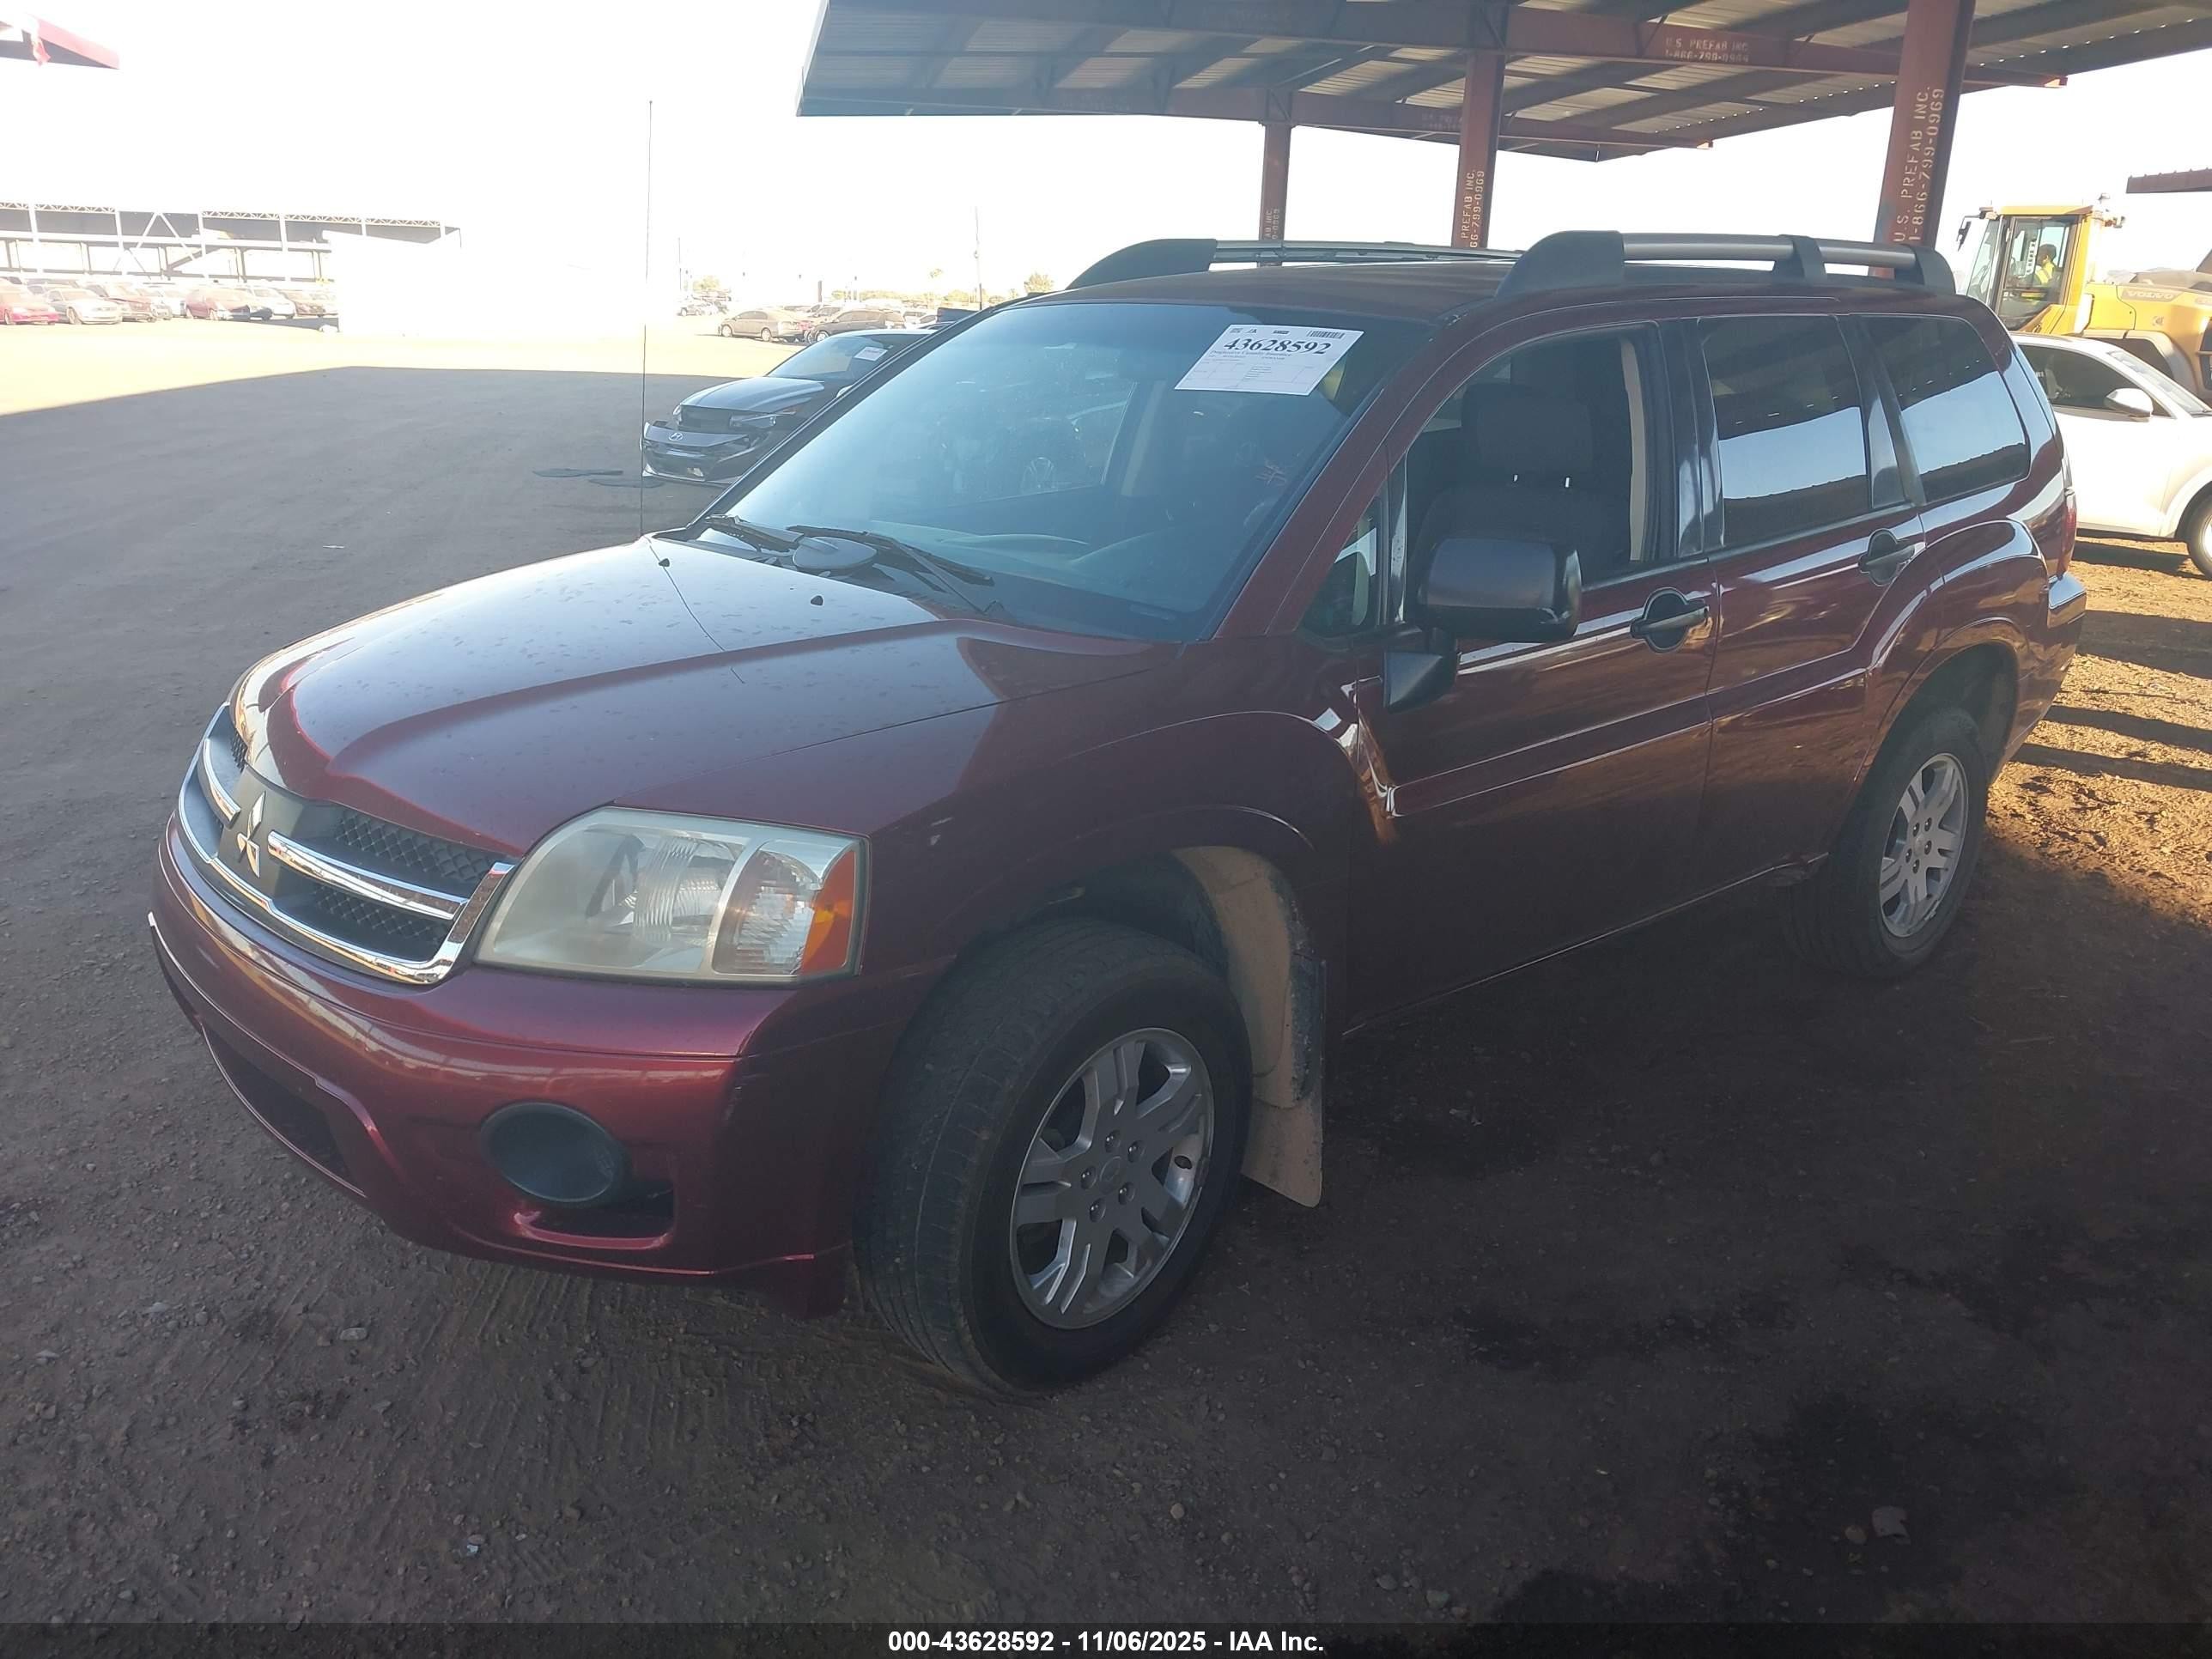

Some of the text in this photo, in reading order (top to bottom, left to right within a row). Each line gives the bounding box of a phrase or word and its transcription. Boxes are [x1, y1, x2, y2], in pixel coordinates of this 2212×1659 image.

[1690, 39, 1728, 51] PREFAB
[1893, 87, 1930, 242] U.S. PREFAB INC.
[1908, 88, 1945, 240] 1-866-799-0969
[1461, 196, 1473, 239] PREFAB
[1469, 171, 1485, 248] 66-799-0969
[1224, 337, 1332, 355] 43628592
